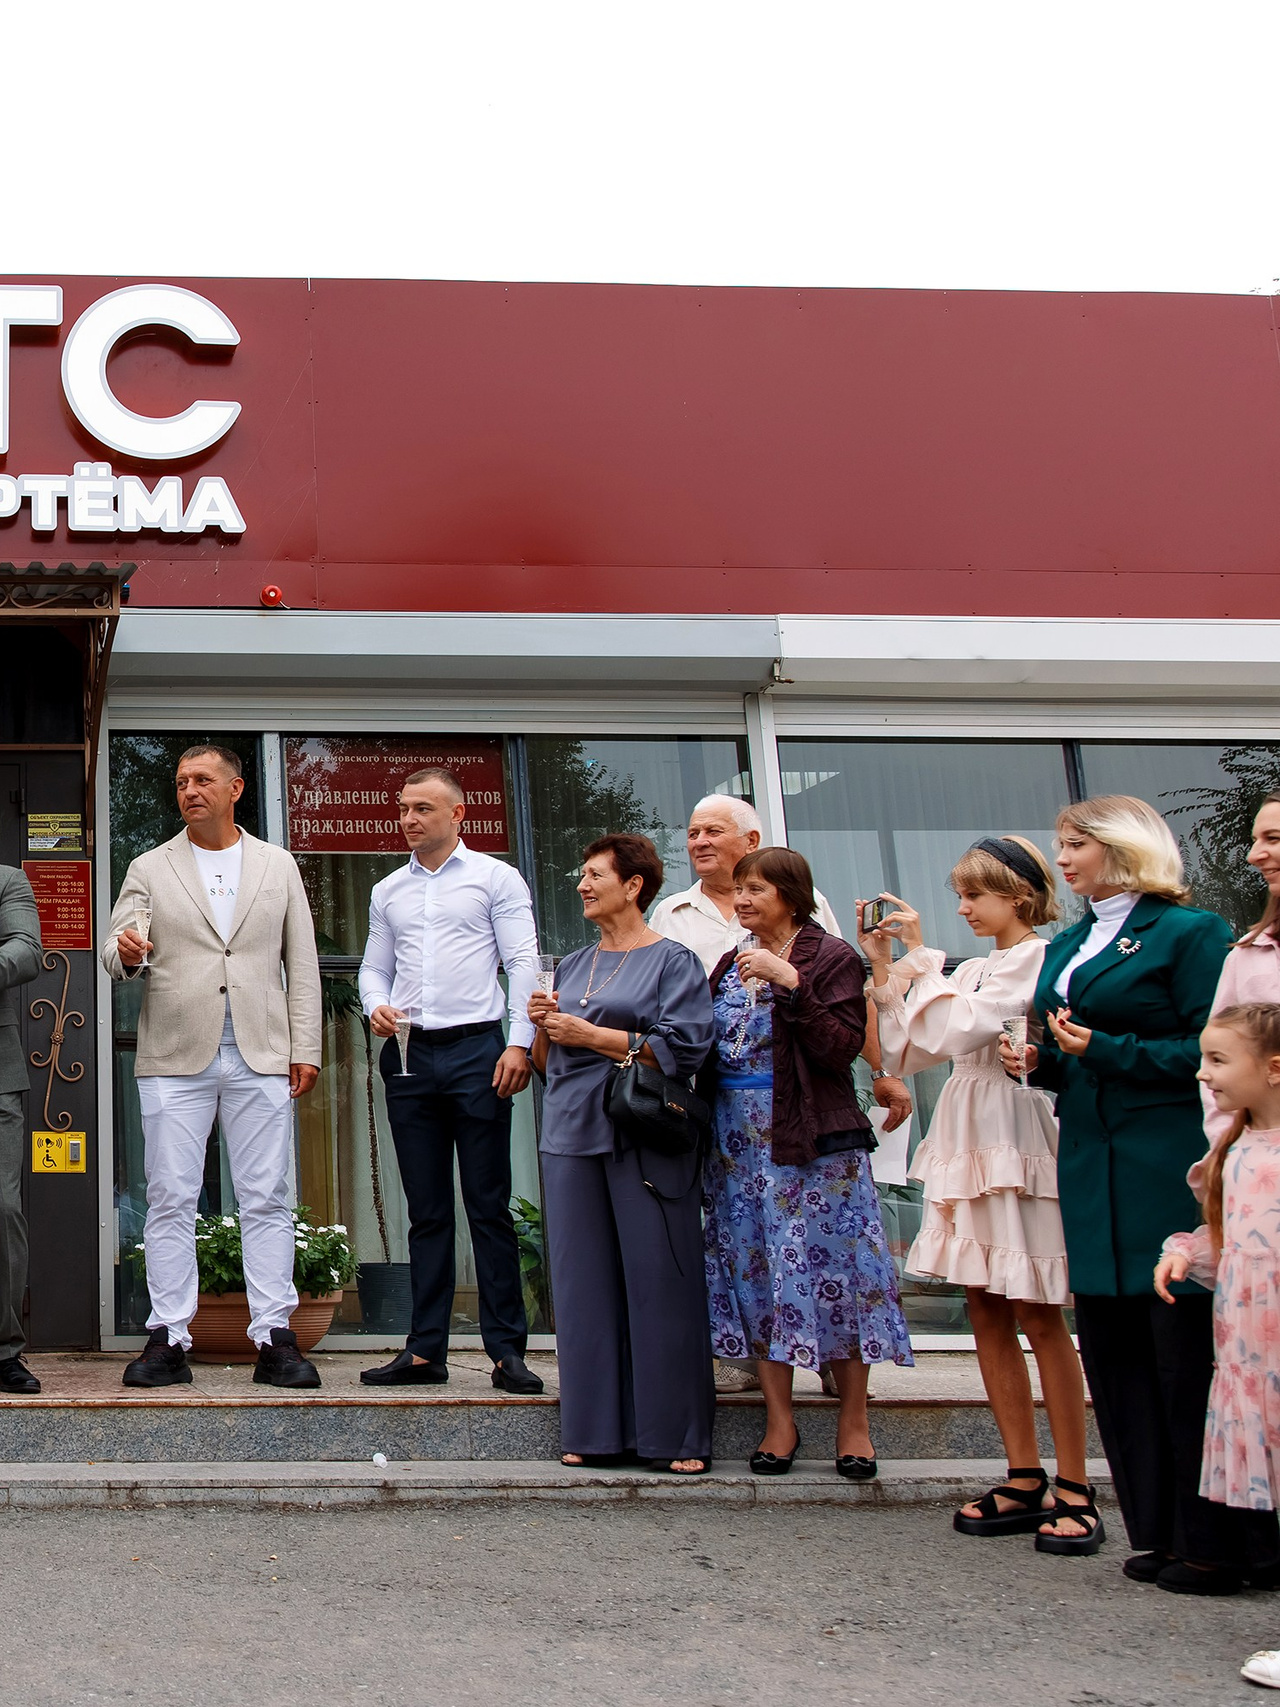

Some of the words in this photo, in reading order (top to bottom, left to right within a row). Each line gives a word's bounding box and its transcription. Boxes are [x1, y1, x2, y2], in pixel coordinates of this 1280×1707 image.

[383, 755, 443, 764] городского
[446, 756, 484, 765] округа
[291, 784, 389, 809] Управление
[293, 819, 401, 838] гражданског
